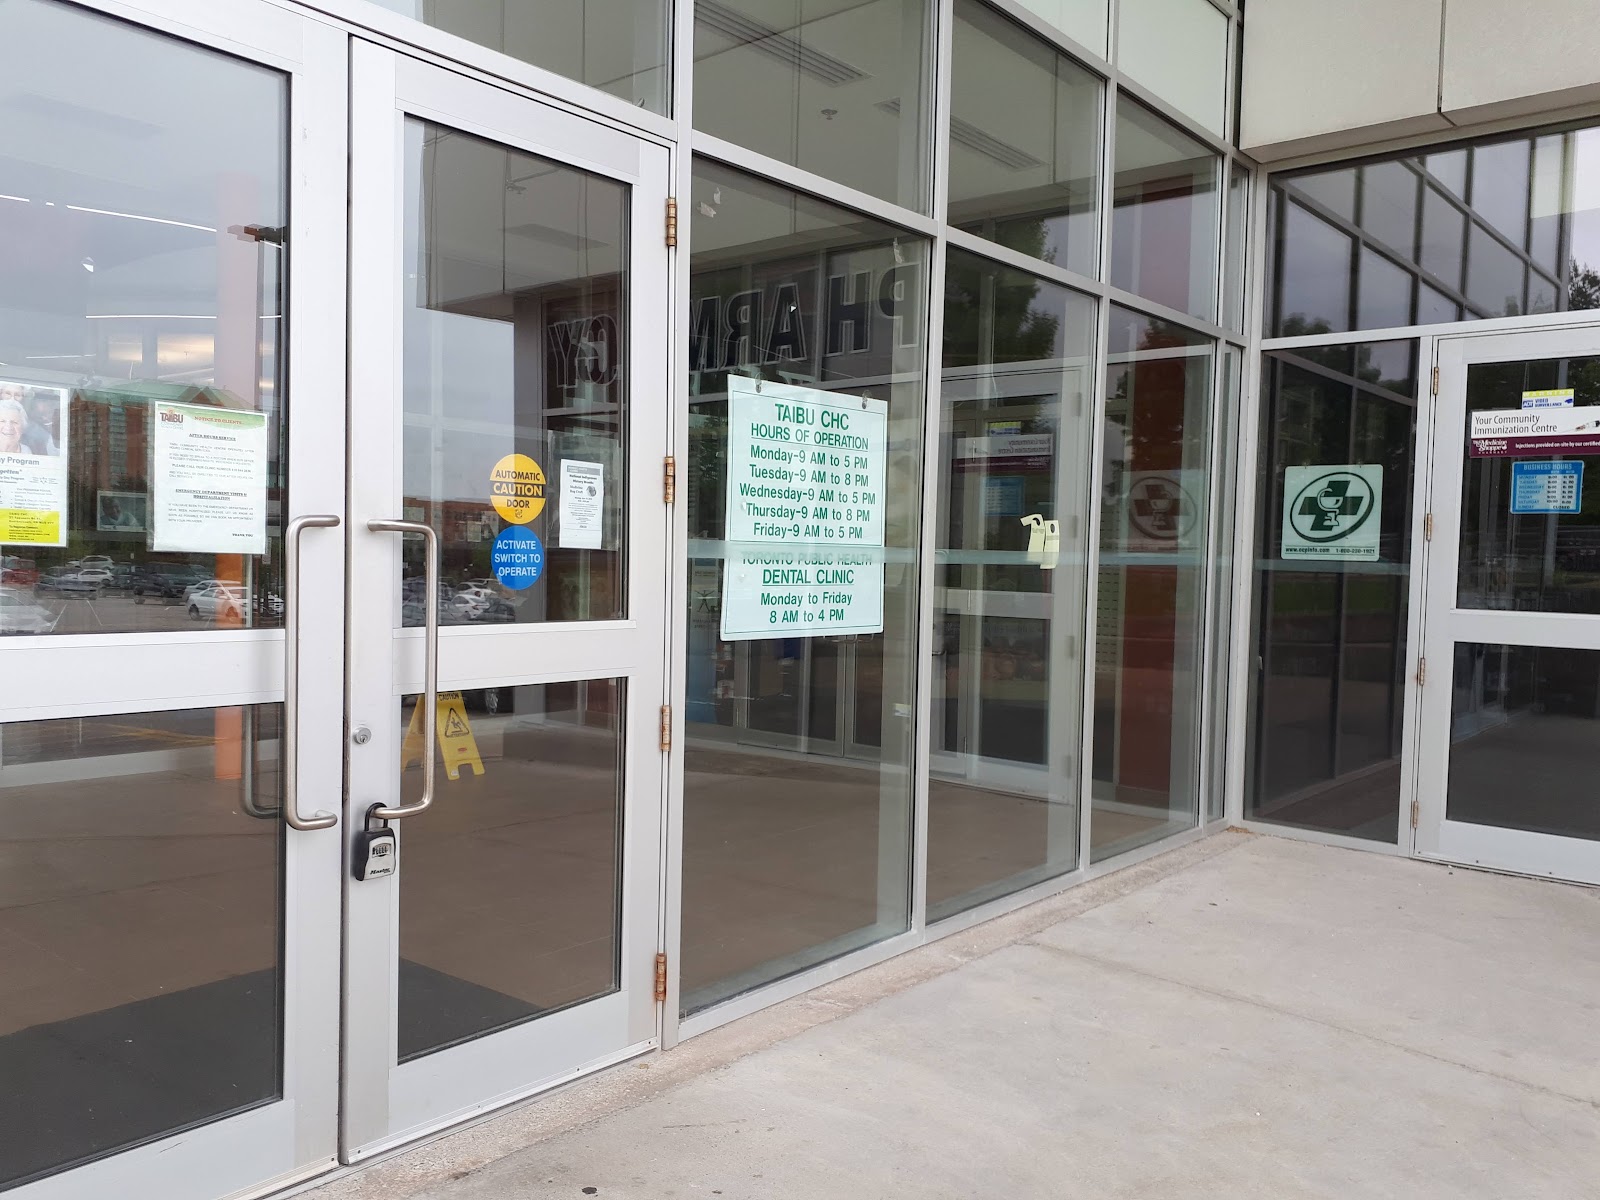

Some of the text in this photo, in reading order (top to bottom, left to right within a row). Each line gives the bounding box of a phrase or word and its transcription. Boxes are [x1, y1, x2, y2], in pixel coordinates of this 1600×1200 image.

[775, 404, 849, 430] TAIBU CHC
[1475, 414, 1540, 425] Your Community
[751, 423, 869, 450] HOURS OF OPERATION
[1475, 424, 1557, 435] Immunization Centre
[8, 456, 40, 466] Program
[750, 445, 868, 470] Monday-9 AM to 5 PM
[496, 470, 540, 481] AUTOMATIC
[750, 464, 869, 487] Tuesday-9 AM to 8 PM
[494, 483, 542, 496] CAUTION
[740, 483, 876, 505] Wednesday-9 AM to 5 PM
[507, 500, 530, 508] DOOR
[746, 503, 870, 522] Thursday-9 AM to 8 PM
[754, 523, 863, 539] Friday-9 AM to 5 PM
[496, 540, 536, 549] ACTIVATE
[495, 554, 540, 563] SWITCH TO
[742, 551, 872, 566] TORONTO PUBLIC HEALTH
[498, 567, 536, 576] OPERATE
[762, 569, 854, 584] DENTAL CLINIC
[760, 591, 852, 607] Monday to Friday
[770, 608, 844, 624] 8 AM to 4 PM
[439, 693, 460, 701] CAUTION
